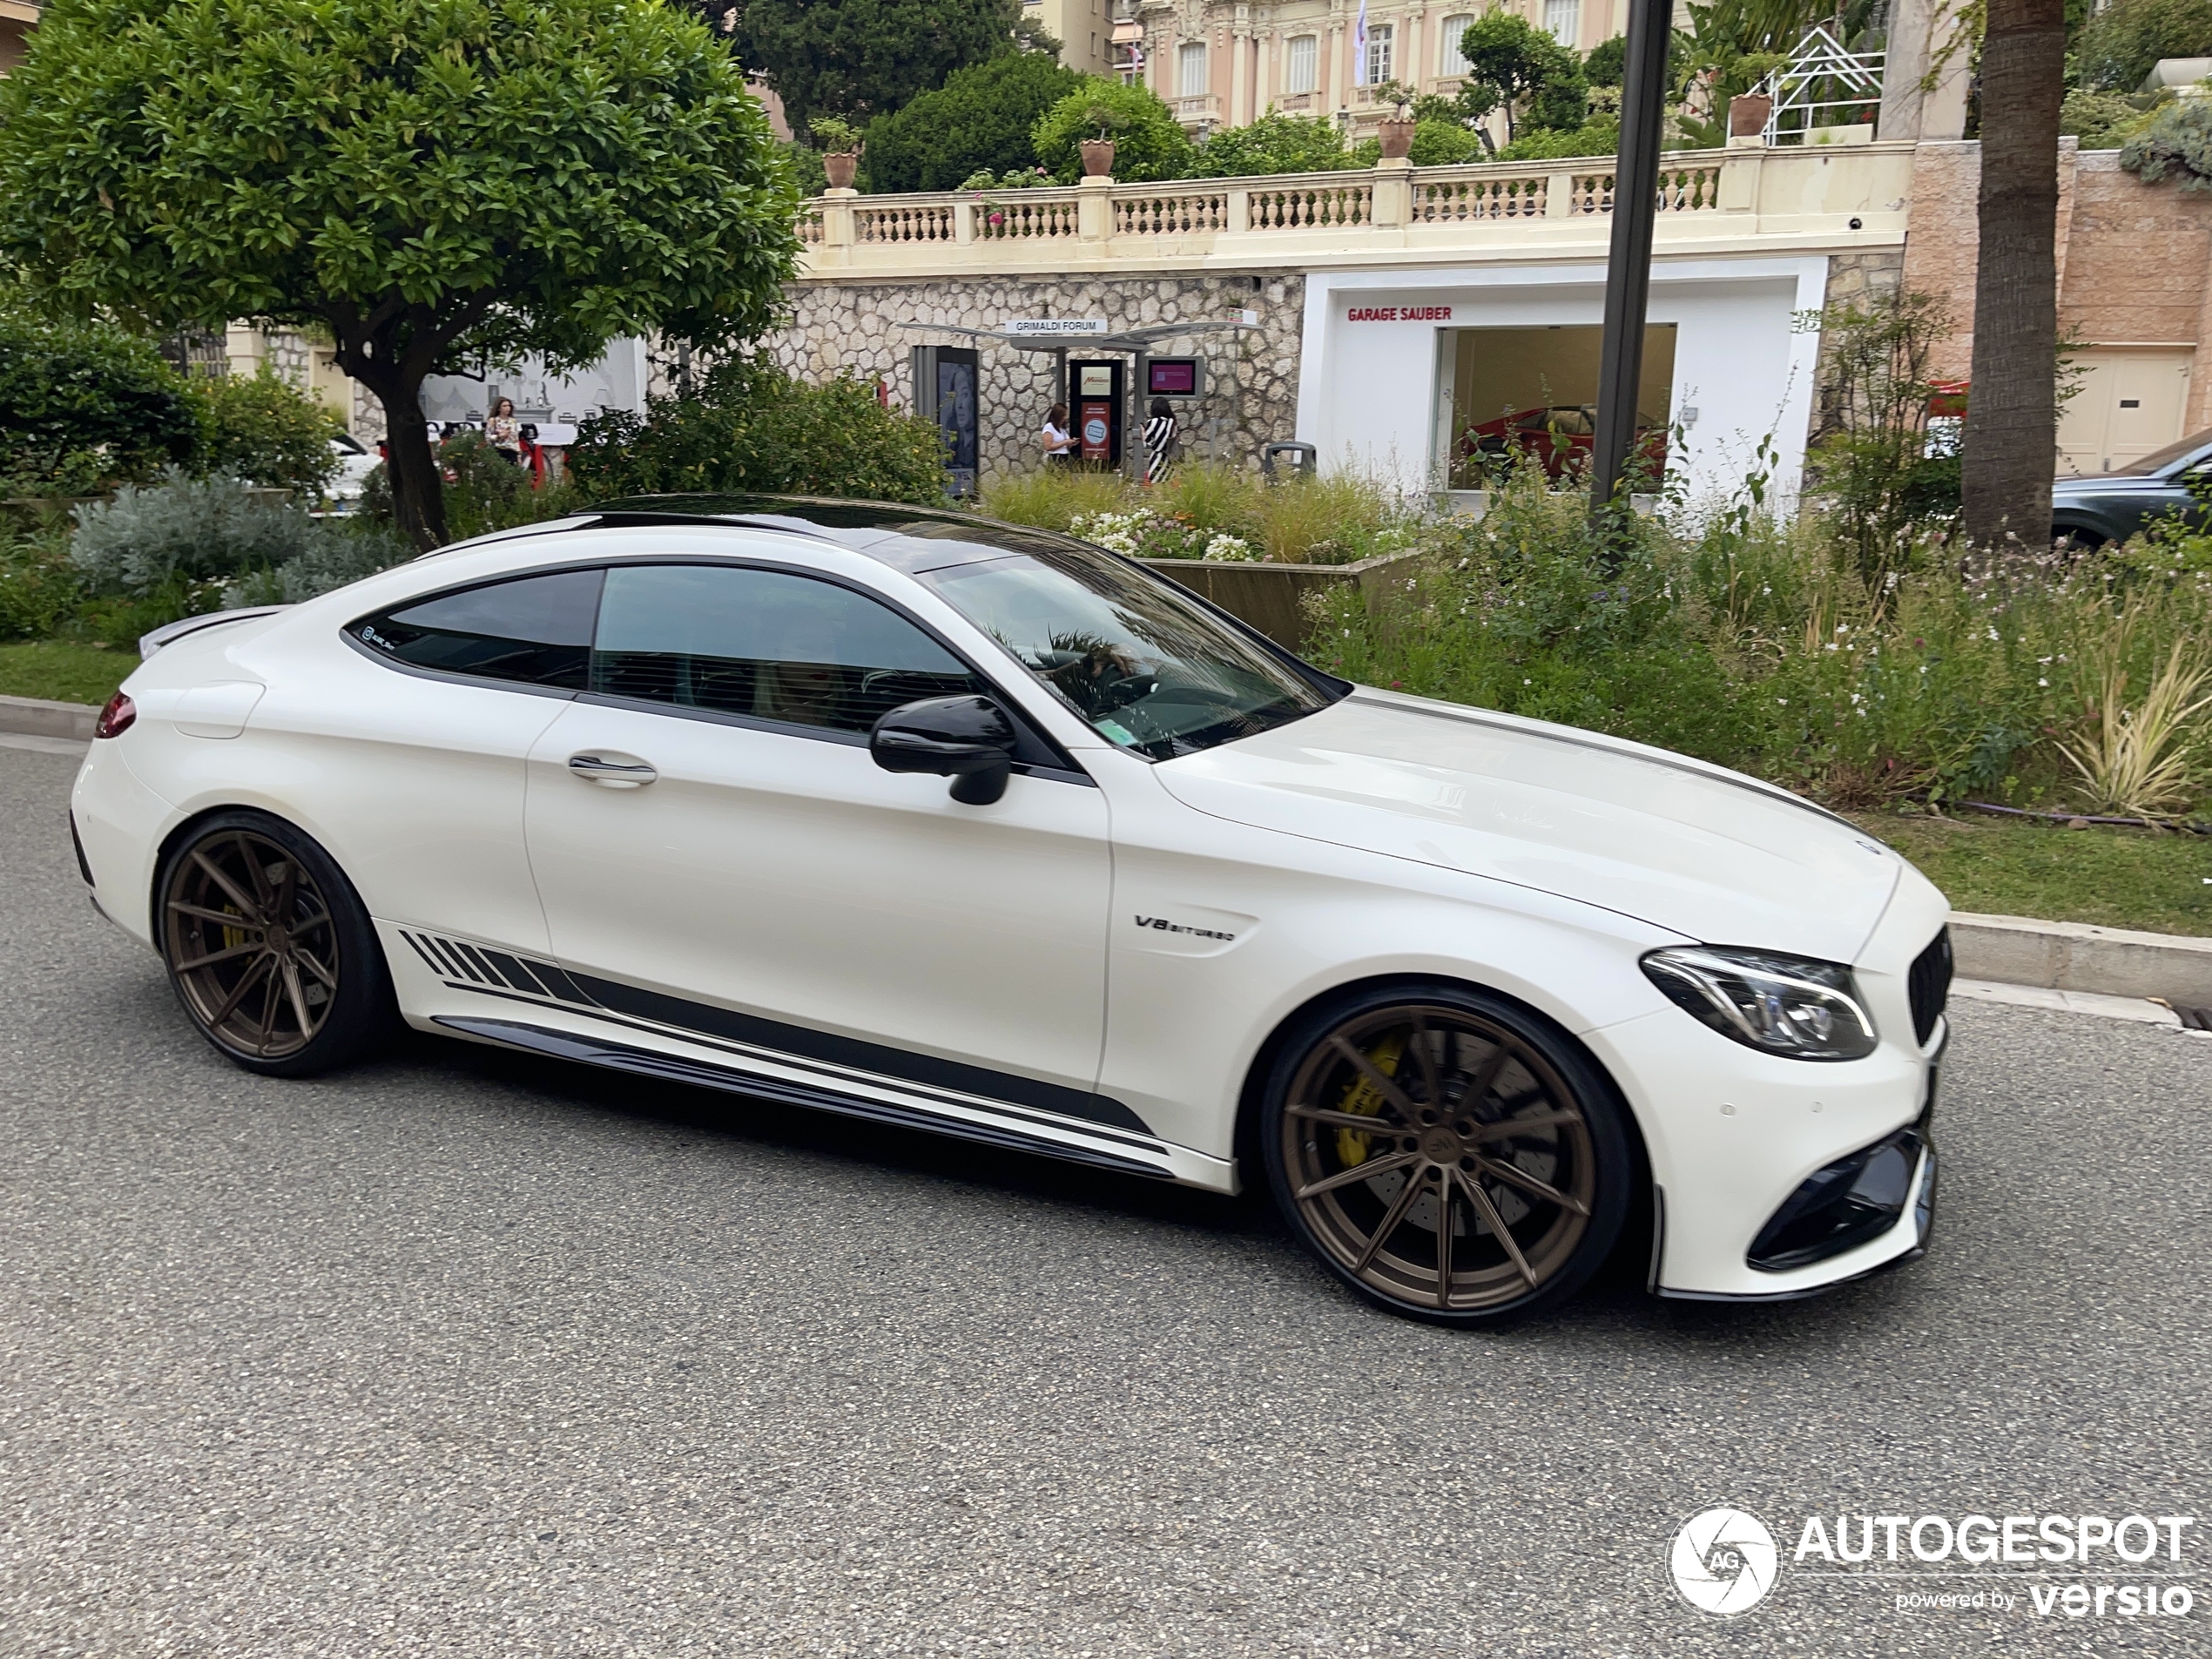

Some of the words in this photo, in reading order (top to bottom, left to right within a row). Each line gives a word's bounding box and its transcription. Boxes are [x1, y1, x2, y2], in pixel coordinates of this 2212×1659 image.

[1348, 307, 1397, 321] GARAGE
[1399, 307, 1452, 320] SAUBER
[1062, 321, 1096, 330] FORUM
[1134, 914, 1170, 931] V8
